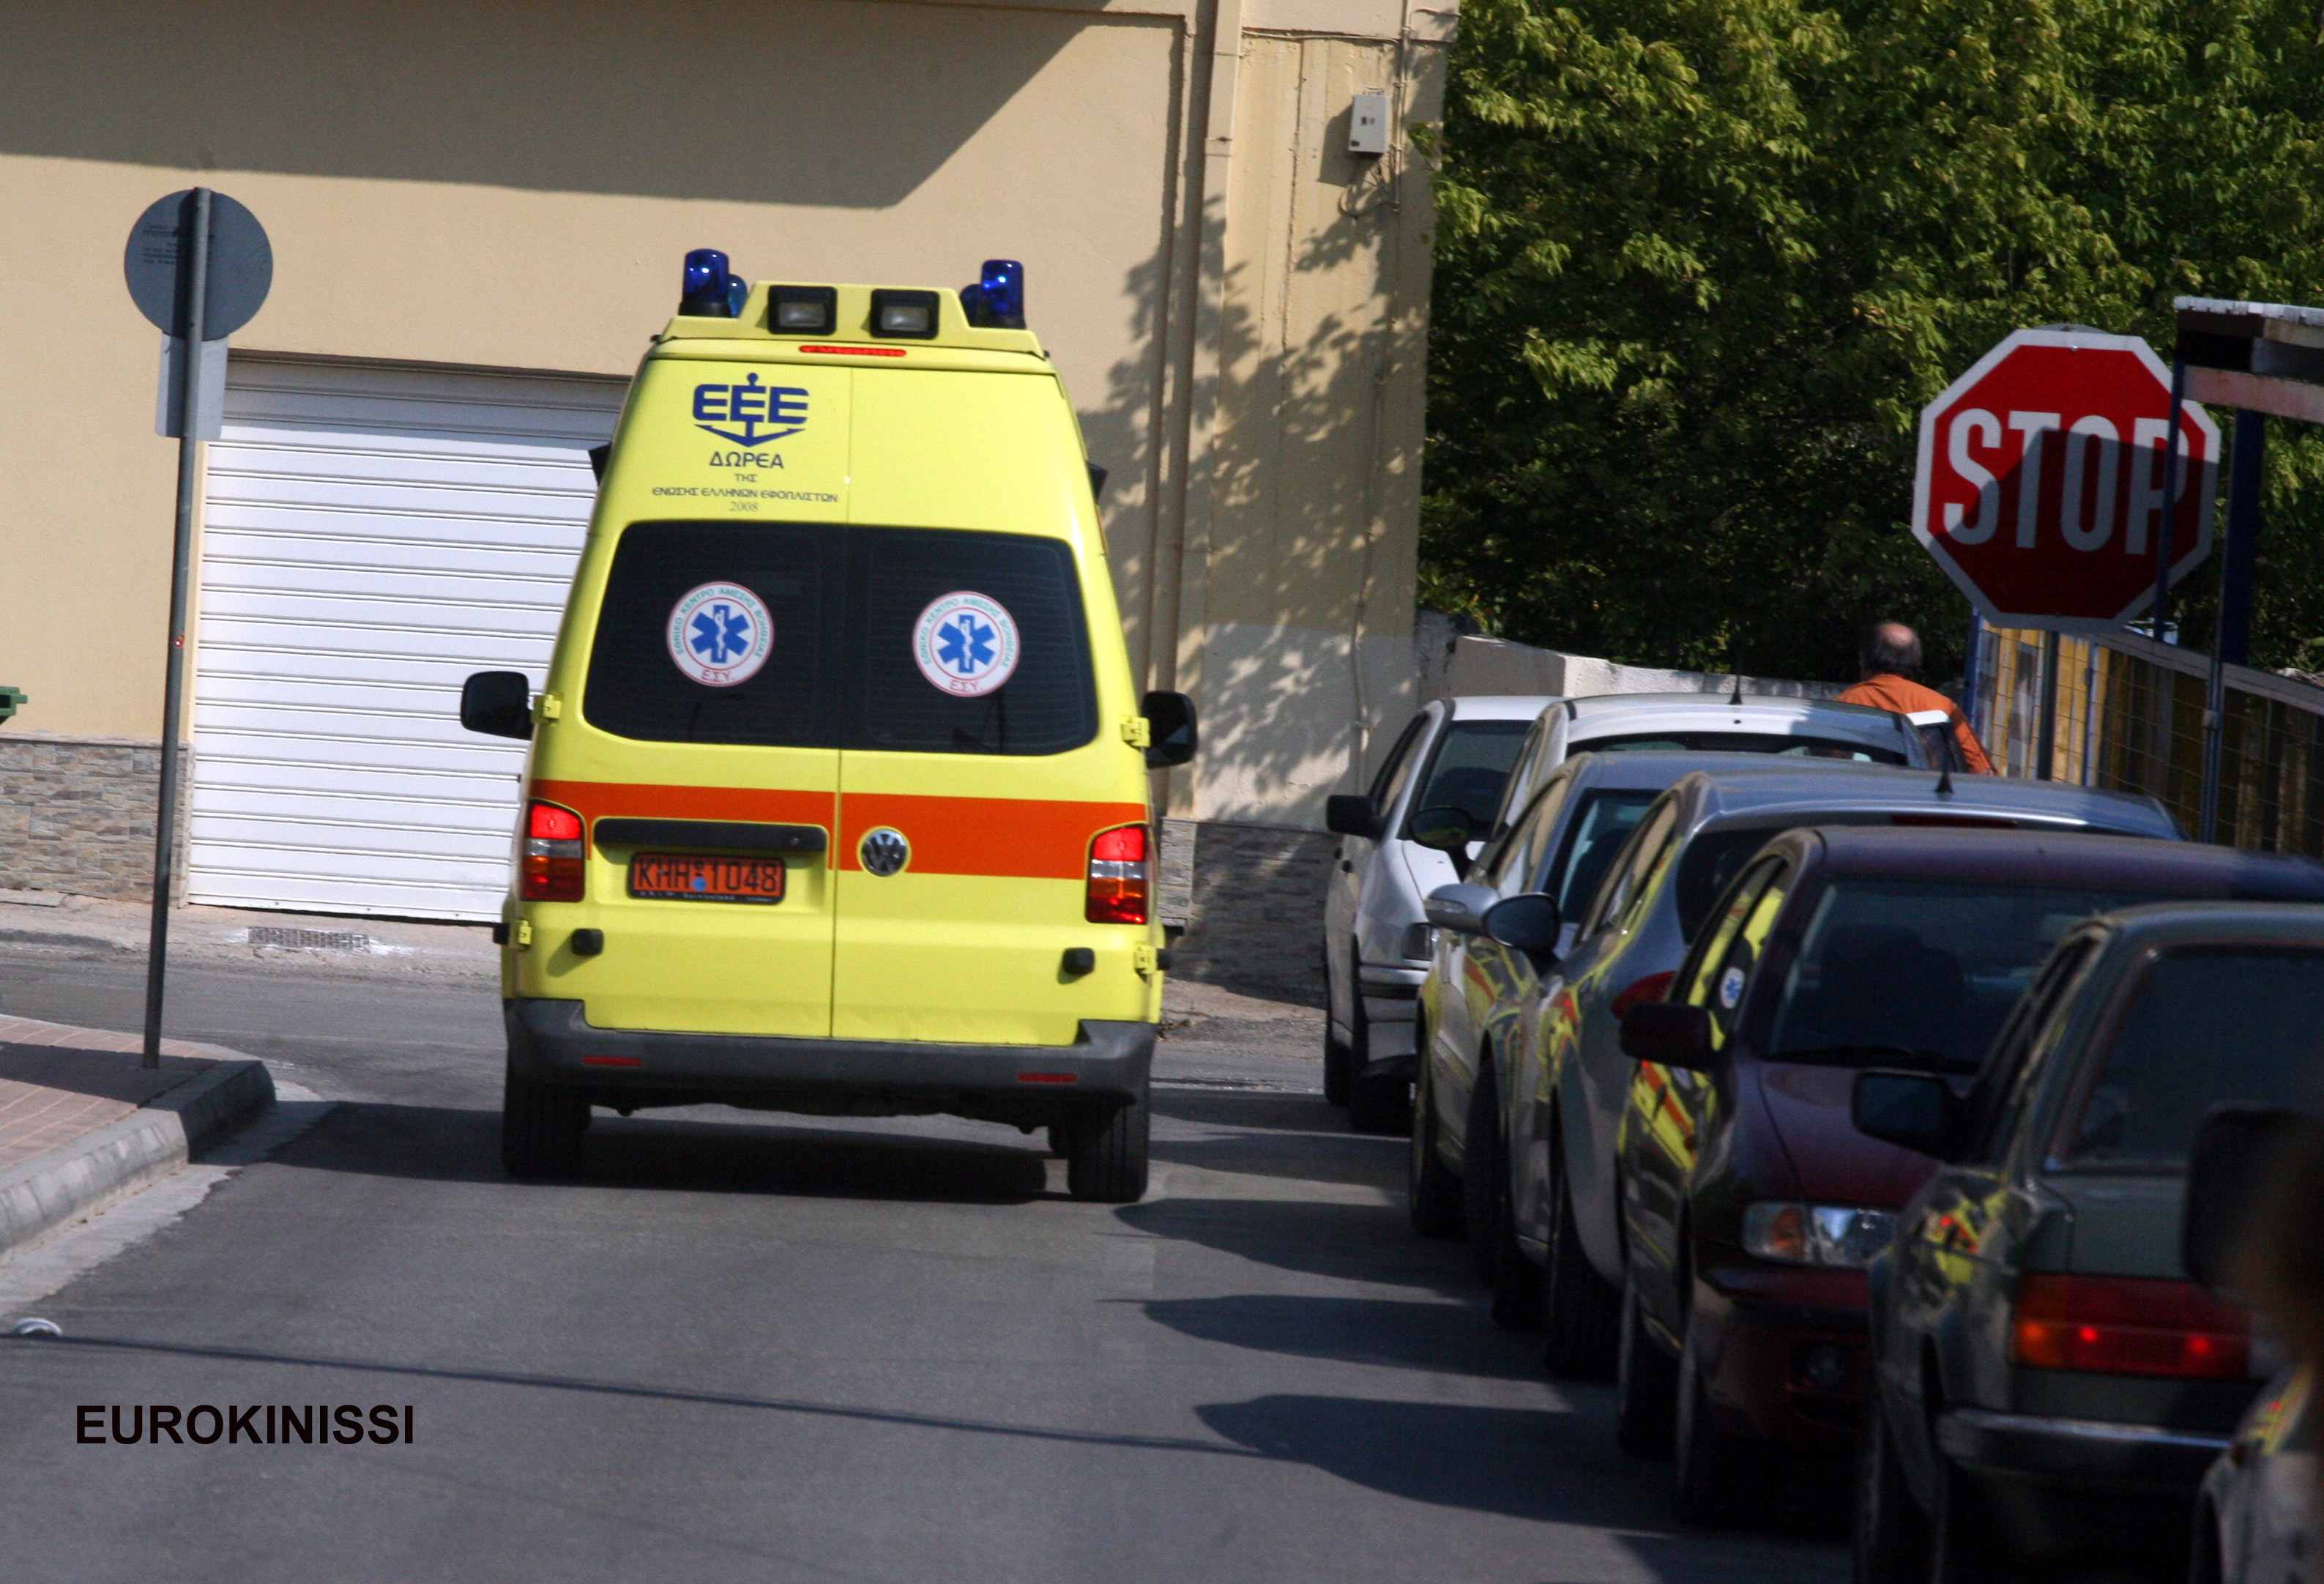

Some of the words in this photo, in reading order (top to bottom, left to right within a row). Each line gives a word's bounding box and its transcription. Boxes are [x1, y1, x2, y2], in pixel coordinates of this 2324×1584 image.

[710, 451, 784, 469] ΔΩΡΕΑ
[734, 473, 758, 483] ΤΗΣ
[1943, 409, 2189, 555] STOP
[652, 487, 699, 497] ΕΝΩΣΗΣ
[701, 488, 757, 498] ΕΛΛΗΝΩΝ
[760, 491, 838, 502] ΕΦΟΠΛΙΣΤΩΝ
[730, 501, 759, 511] 2008
